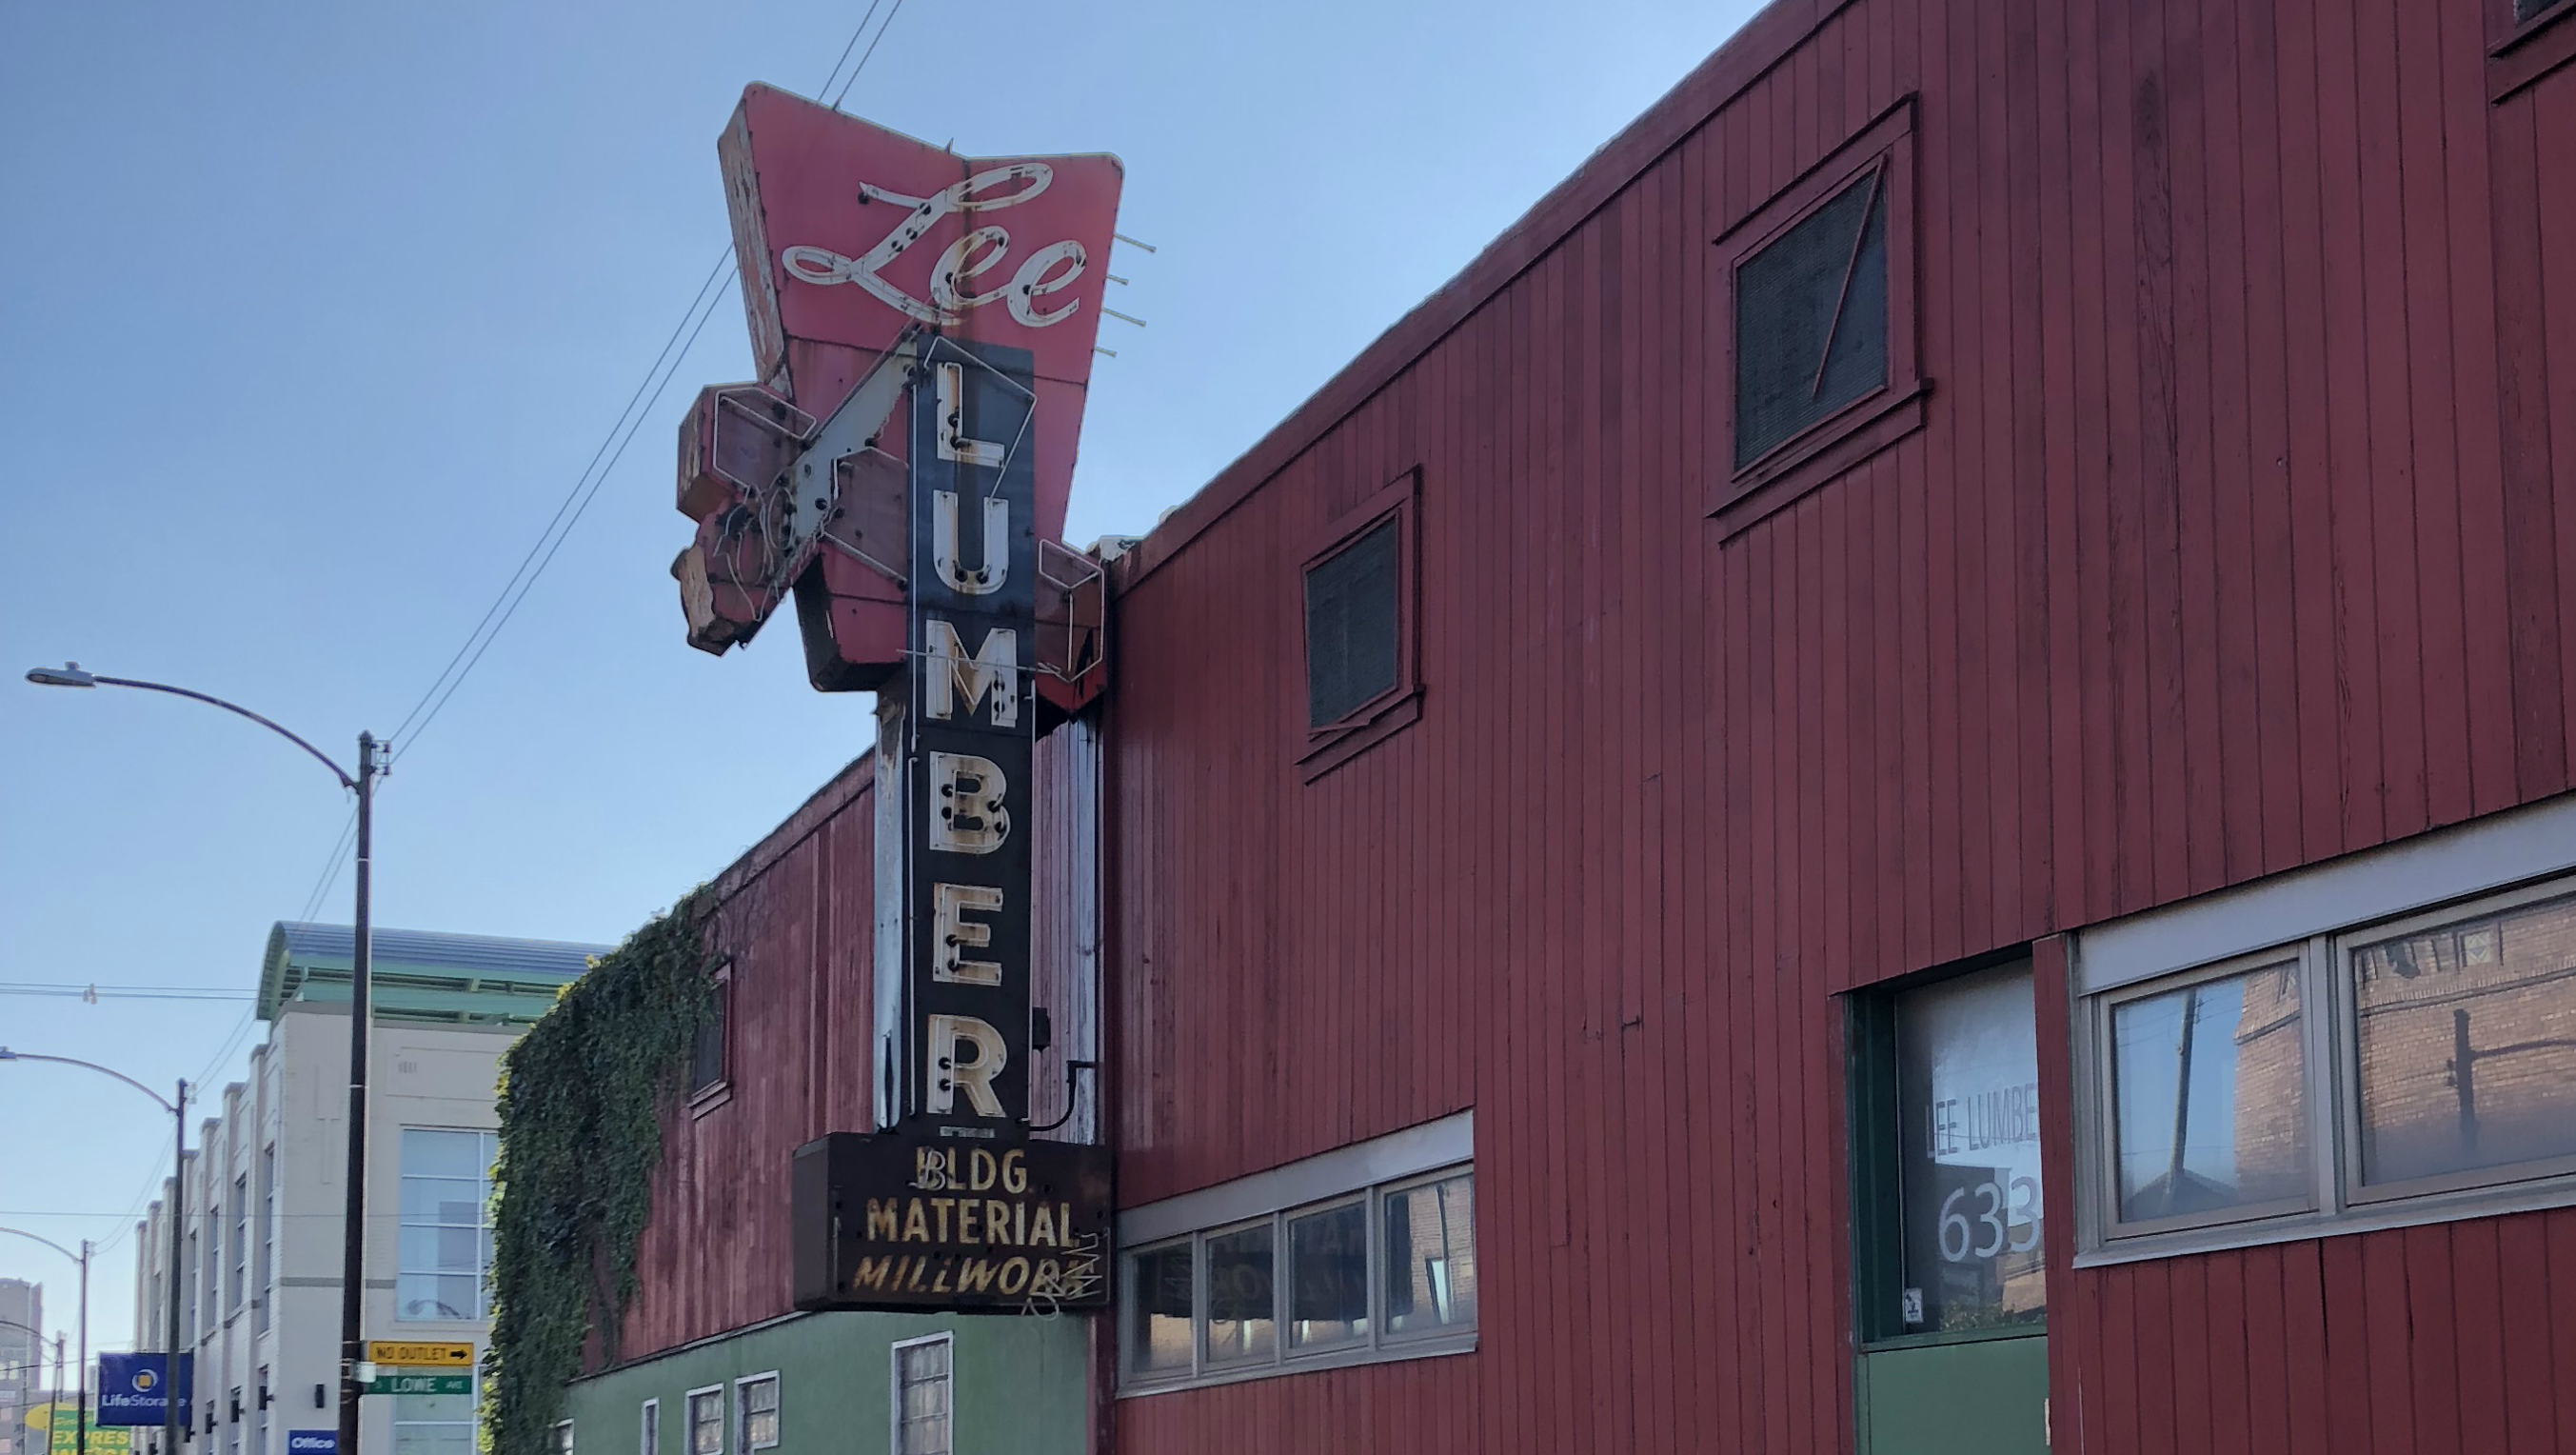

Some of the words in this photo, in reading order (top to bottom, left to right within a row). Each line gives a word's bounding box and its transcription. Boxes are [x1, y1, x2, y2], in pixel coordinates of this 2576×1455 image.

[782, 162, 1086, 328] Lee
[924, 361, 1018, 1119] LUMBER
[1926, 1099, 1958, 1158] LEE
[916, 1146, 1027, 1194] BLDG
[866, 1196, 1080, 1247] MATERIAL
[1938, 1176, 2041, 1263] 633
[376, 1346, 394, 1359] NO
[400, 1347, 446, 1360] OUTLET
[101, 1393, 187, 1407] LifeStorae
[390, 1377, 437, 1392] LOWE
[291, 1436, 335, 1448] Office
